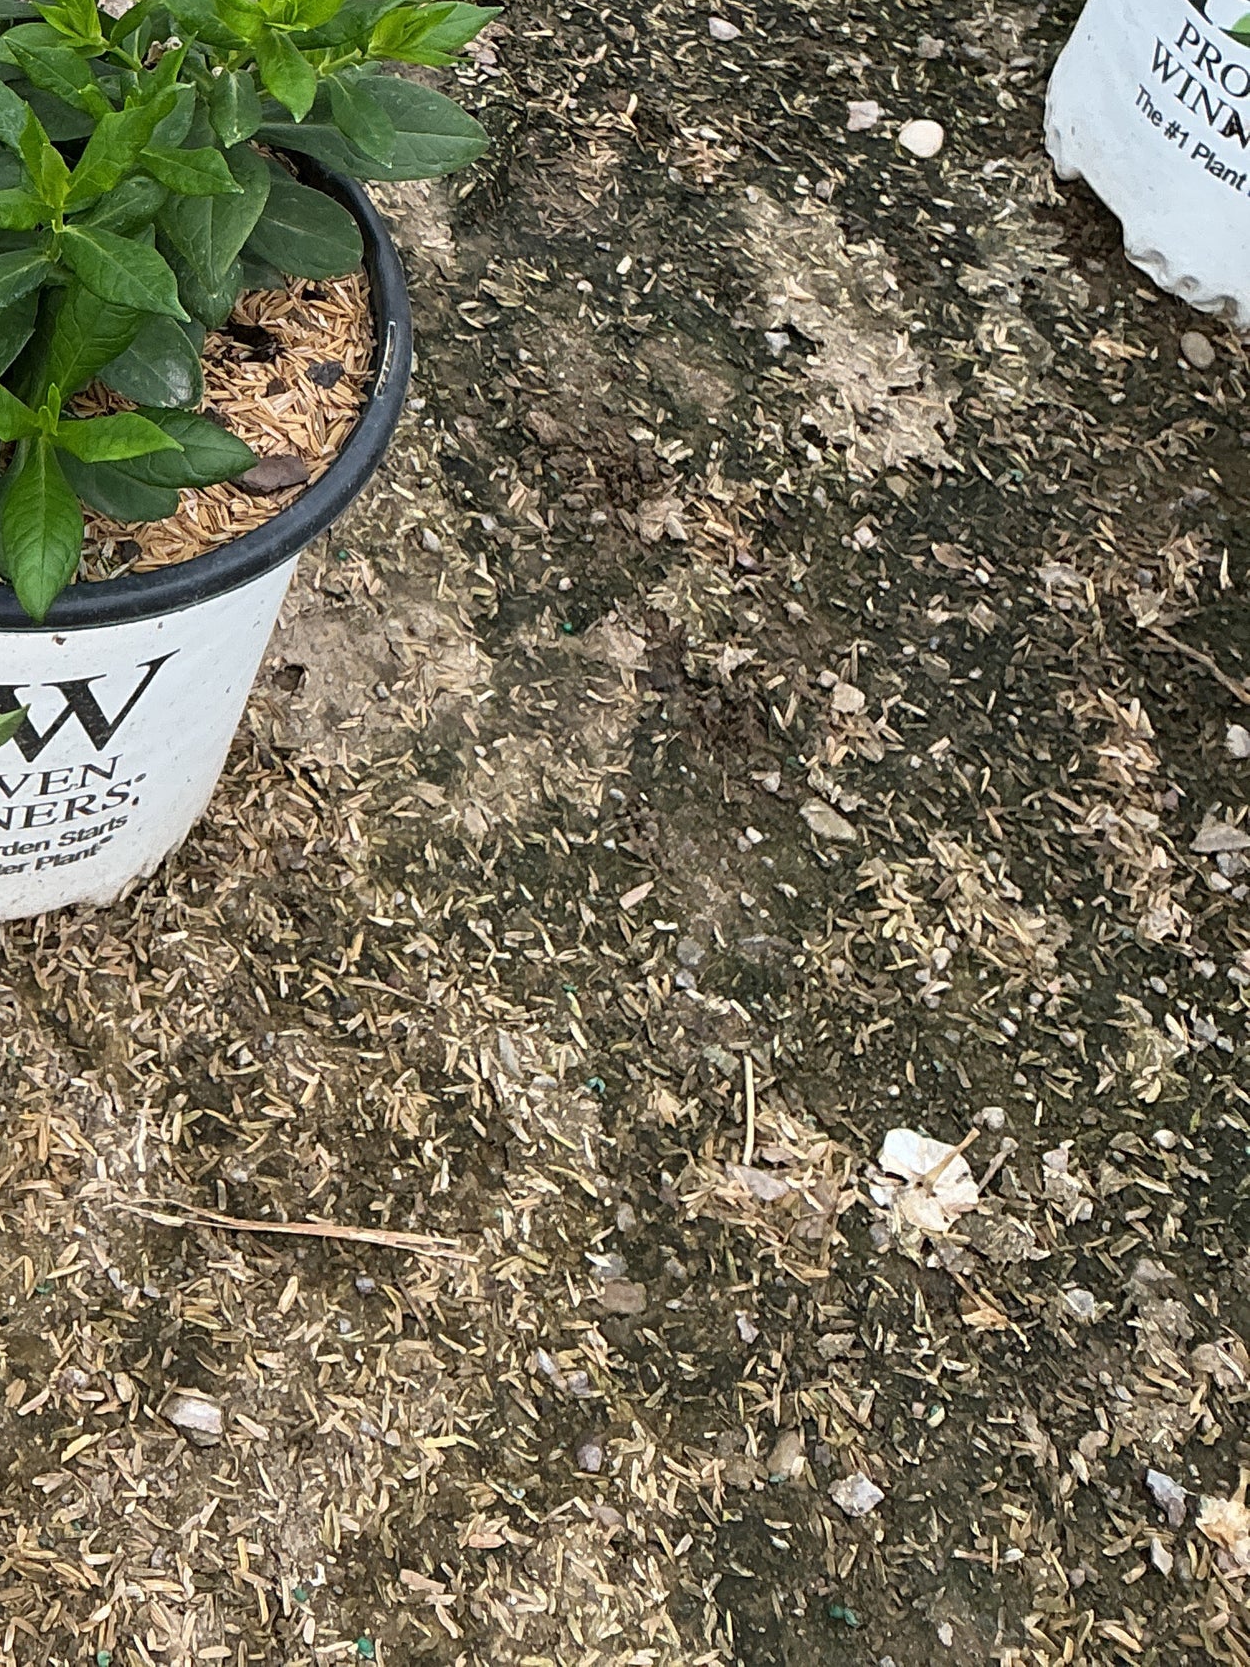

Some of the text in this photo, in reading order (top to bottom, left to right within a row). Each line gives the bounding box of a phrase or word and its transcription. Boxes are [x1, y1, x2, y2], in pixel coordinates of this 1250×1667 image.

[1135, 83, 1248, 192] The #1 Plant
[57, 814, 129, 848] Starts
